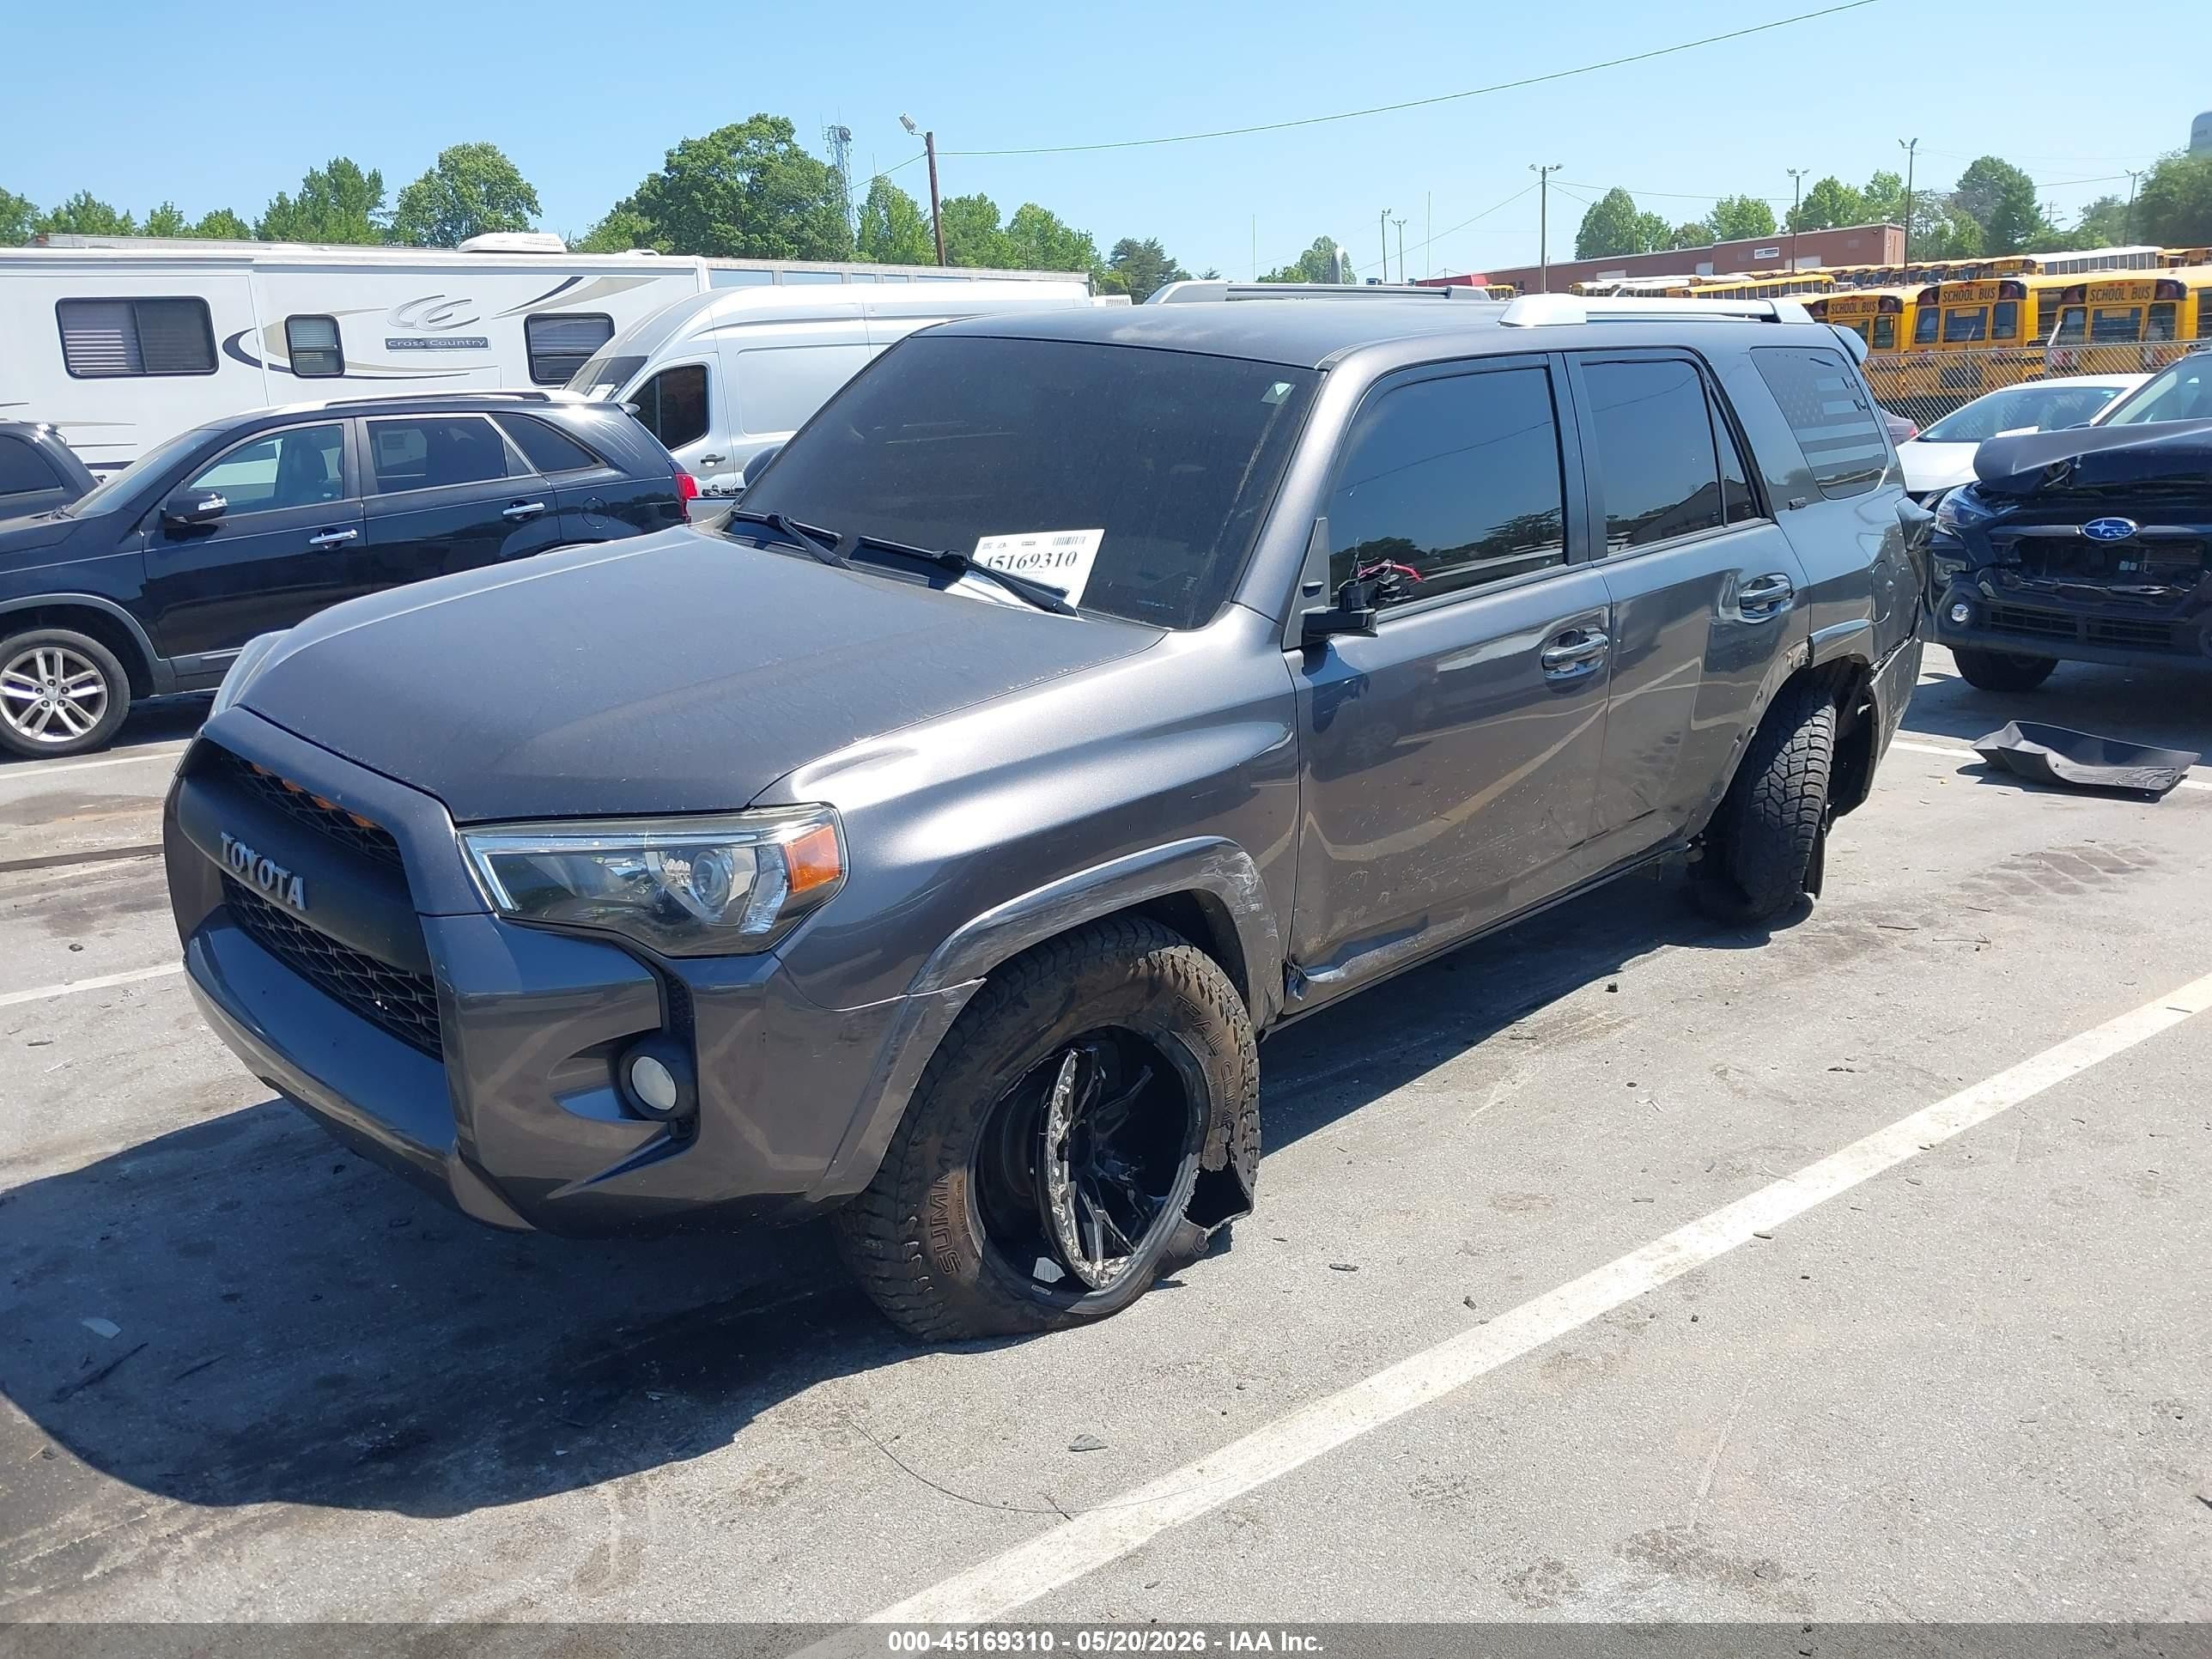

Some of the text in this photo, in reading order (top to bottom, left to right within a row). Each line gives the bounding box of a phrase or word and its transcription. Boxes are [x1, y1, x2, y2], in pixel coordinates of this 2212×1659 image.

[1942, 287, 1996, 303] SCHOOL BUS
[2089, 286, 2151, 302] SCHOOL BUS
[1830, 300, 1876, 315] SCHOOL BUS
[429, 339, 485, 348] Country
[221, 831, 307, 911] TOYOTA
